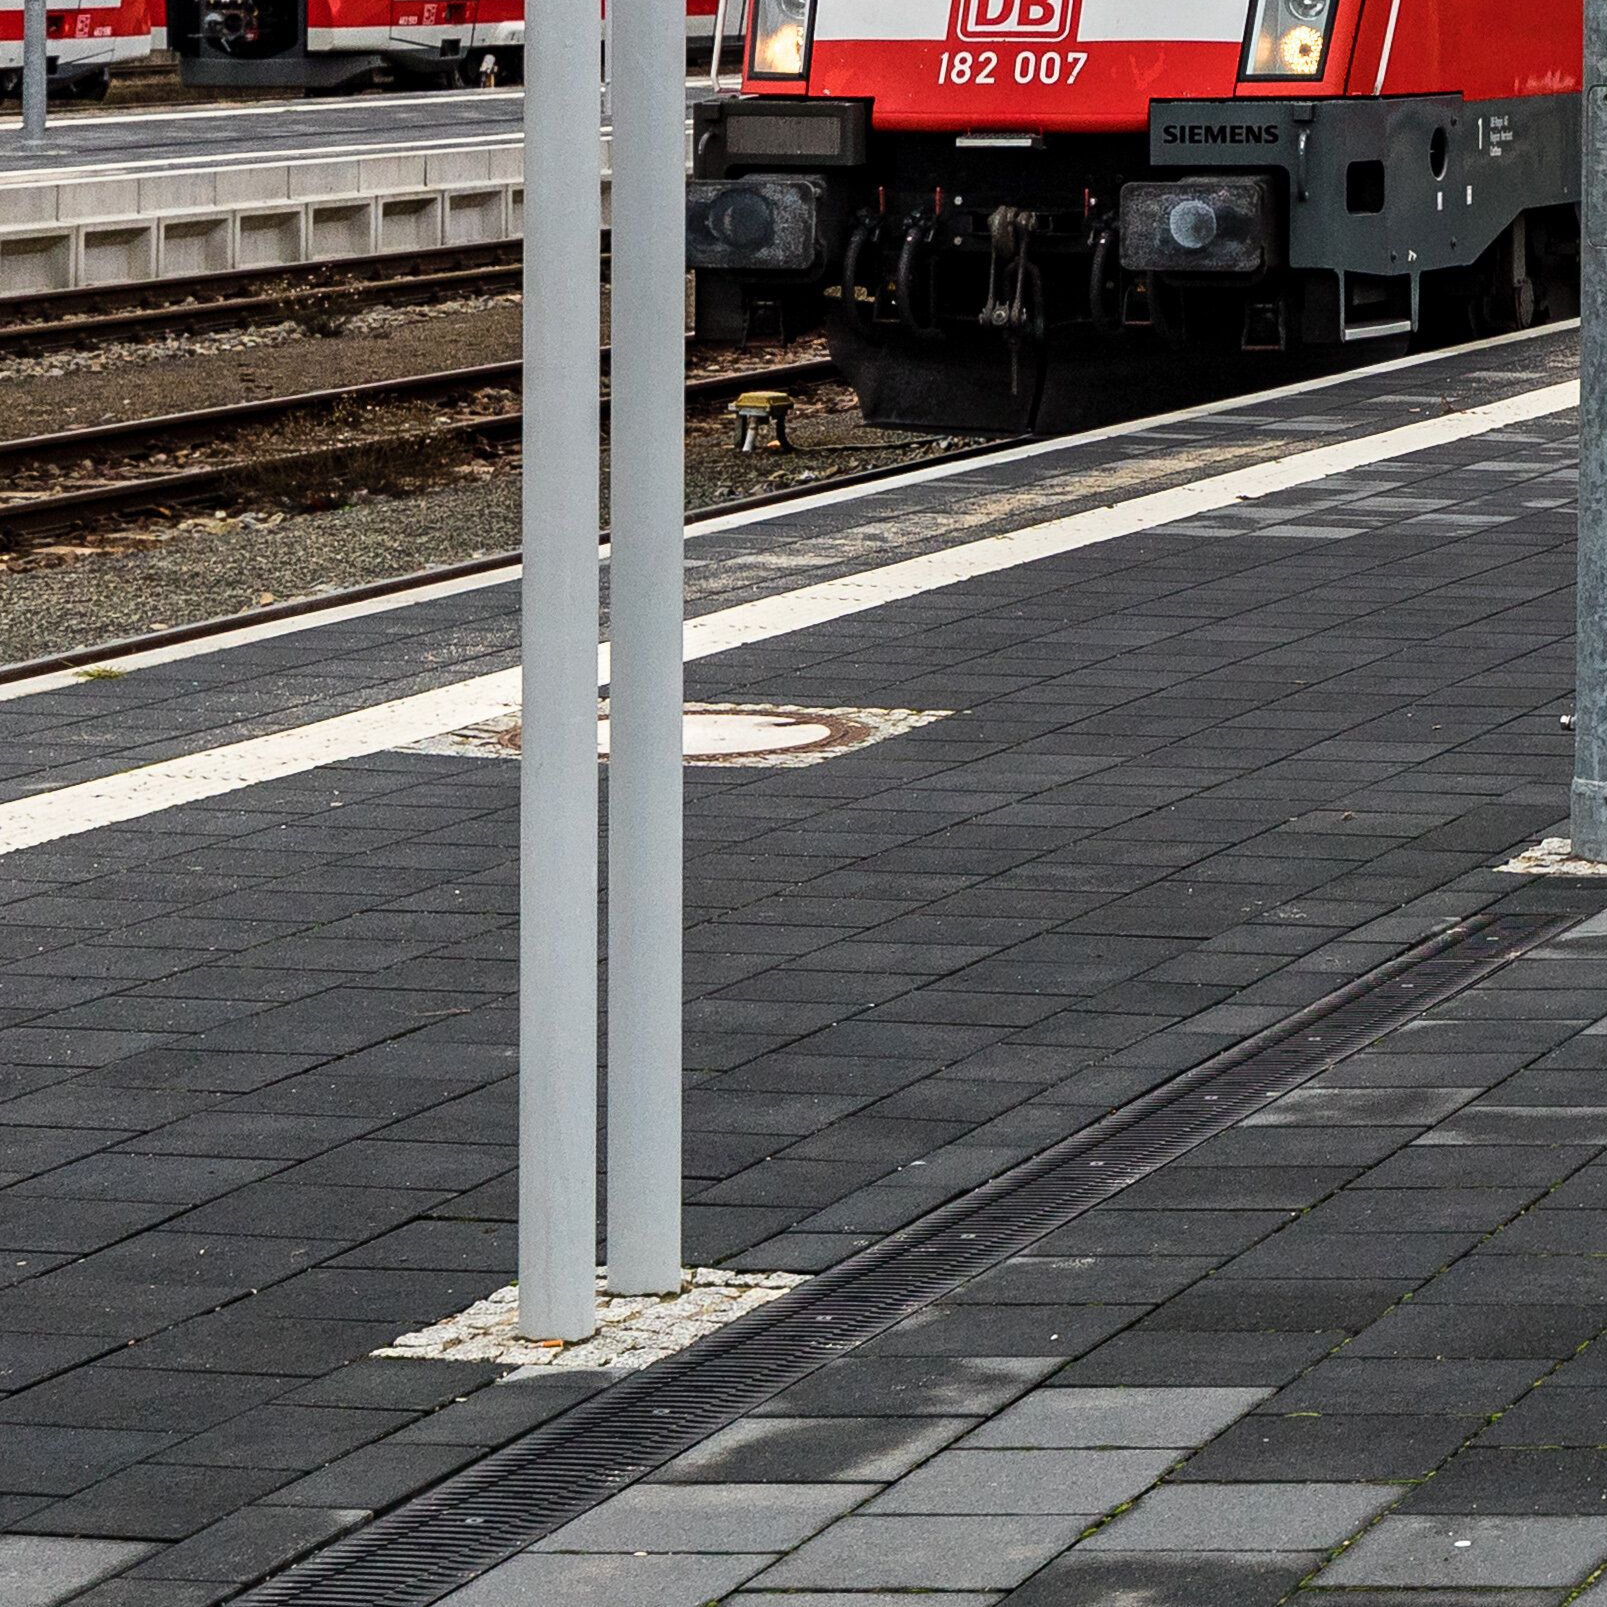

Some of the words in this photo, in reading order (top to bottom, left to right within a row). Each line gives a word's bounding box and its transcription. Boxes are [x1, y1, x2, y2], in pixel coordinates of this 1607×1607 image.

[937, 50, 999, 85] 182
[1013, 50, 1089, 85] 007
[1162, 124, 1280, 145] SIEMENS
